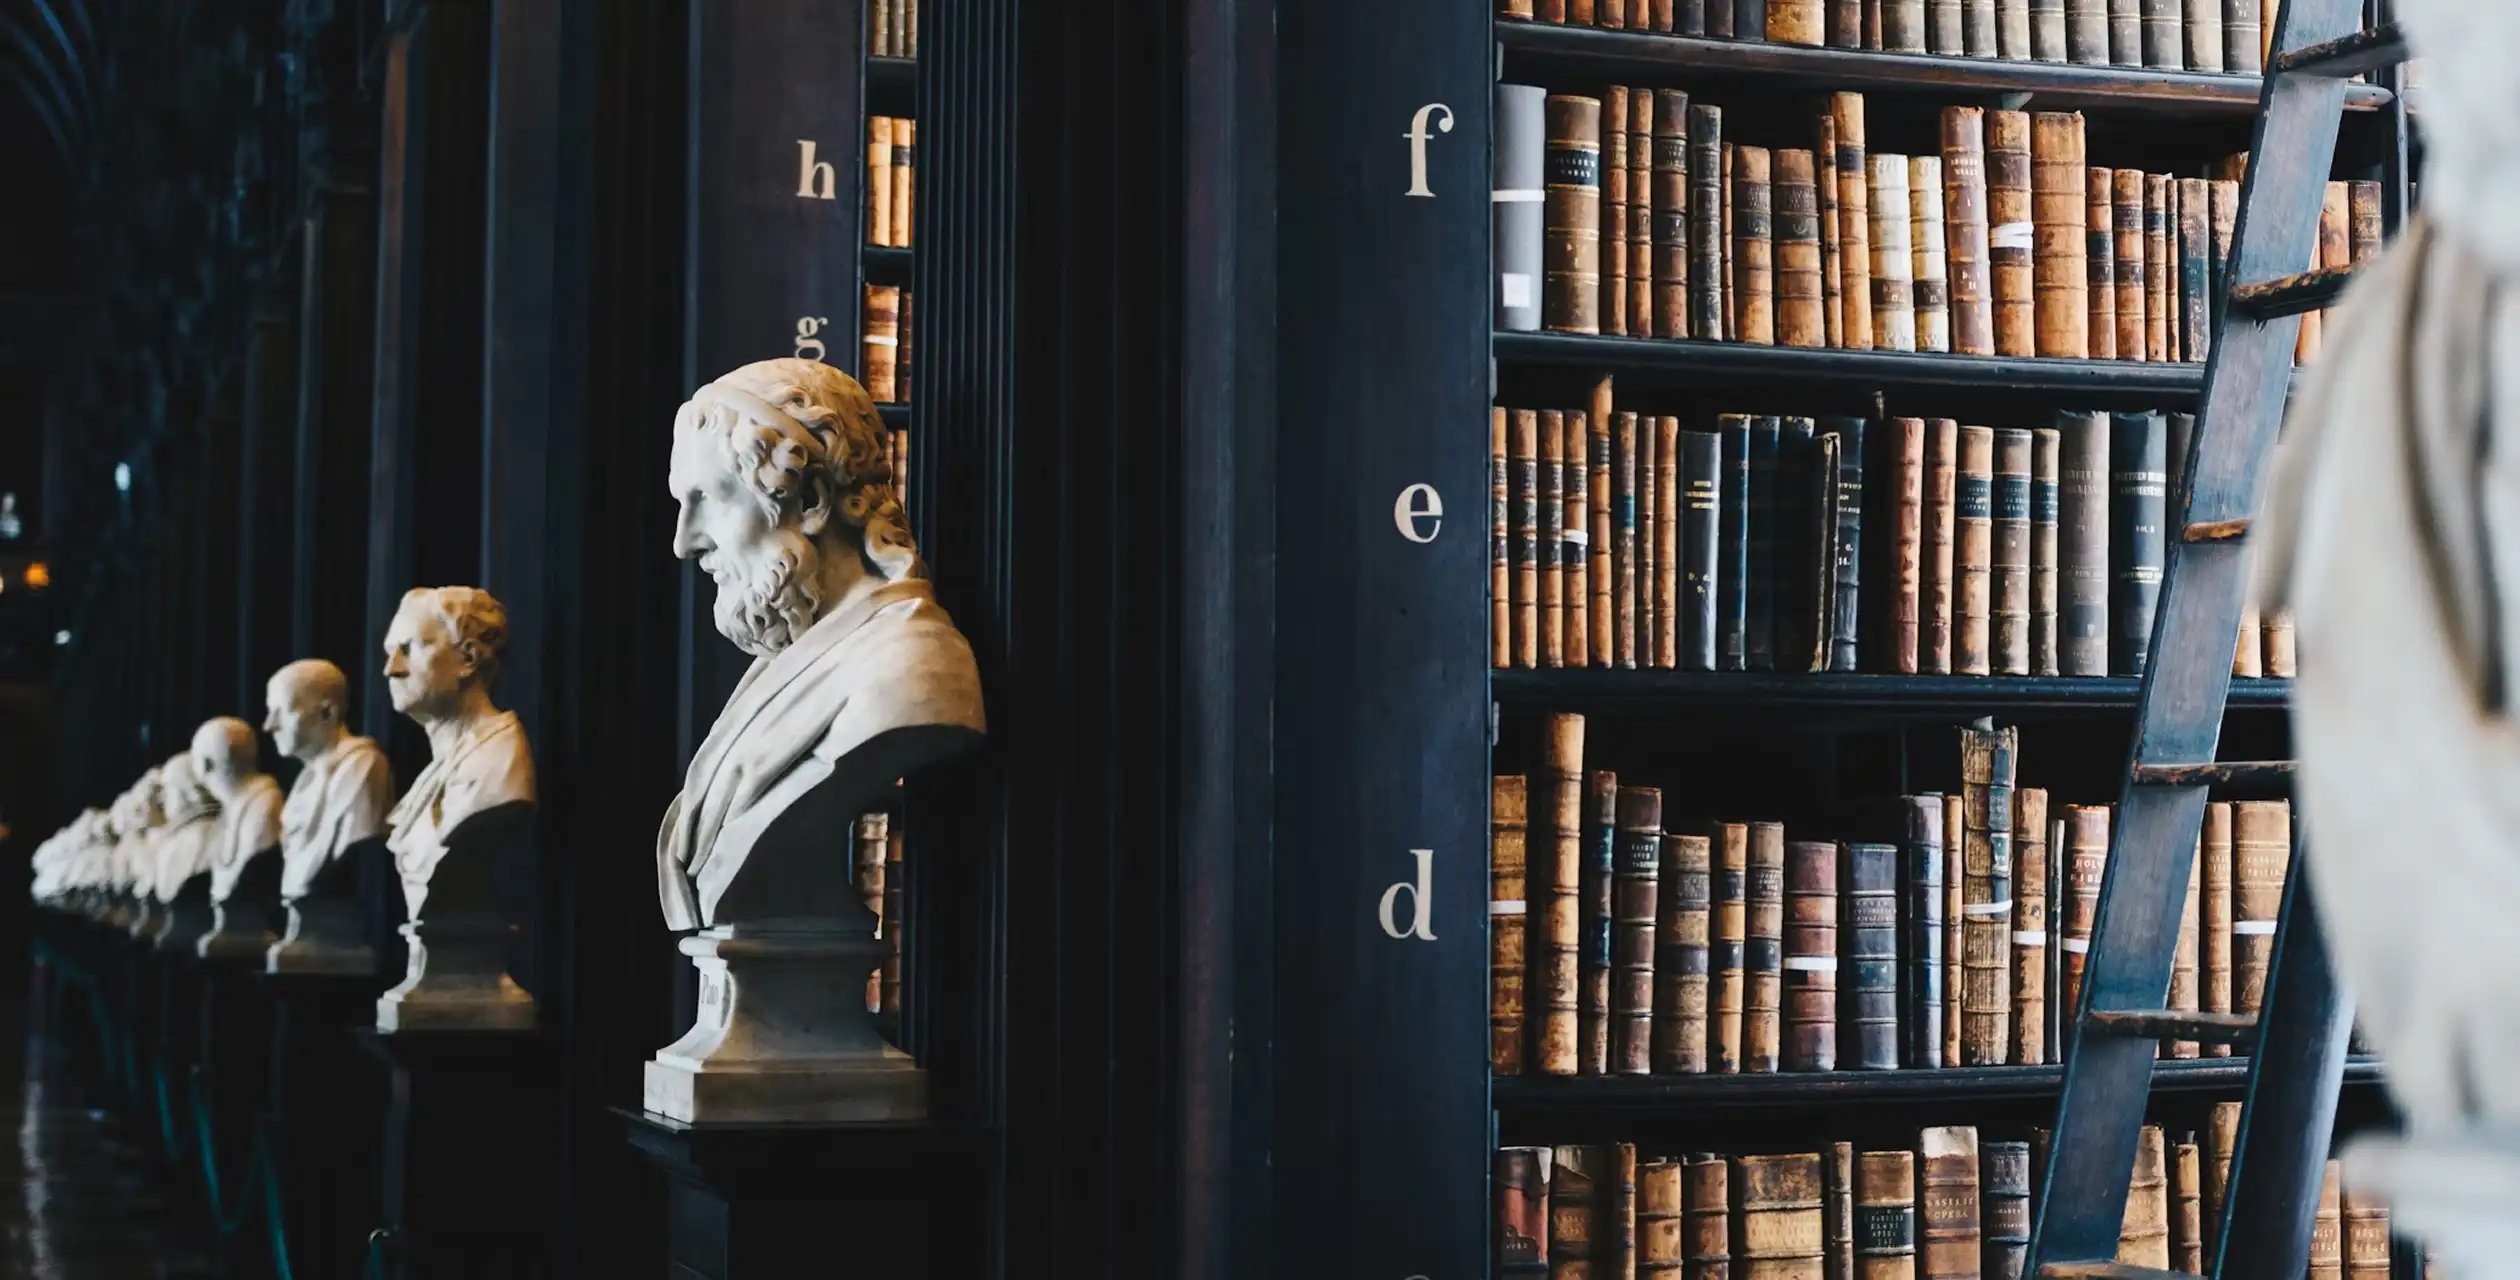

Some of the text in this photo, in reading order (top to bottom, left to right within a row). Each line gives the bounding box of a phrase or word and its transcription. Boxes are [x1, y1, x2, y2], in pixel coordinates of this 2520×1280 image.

[796, 140, 836, 199] h
[1402, 103, 1454, 197] f
[794, 316, 828, 361] g
[1394, 483, 1443, 543] e
[1378, 849, 1438, 940] d
